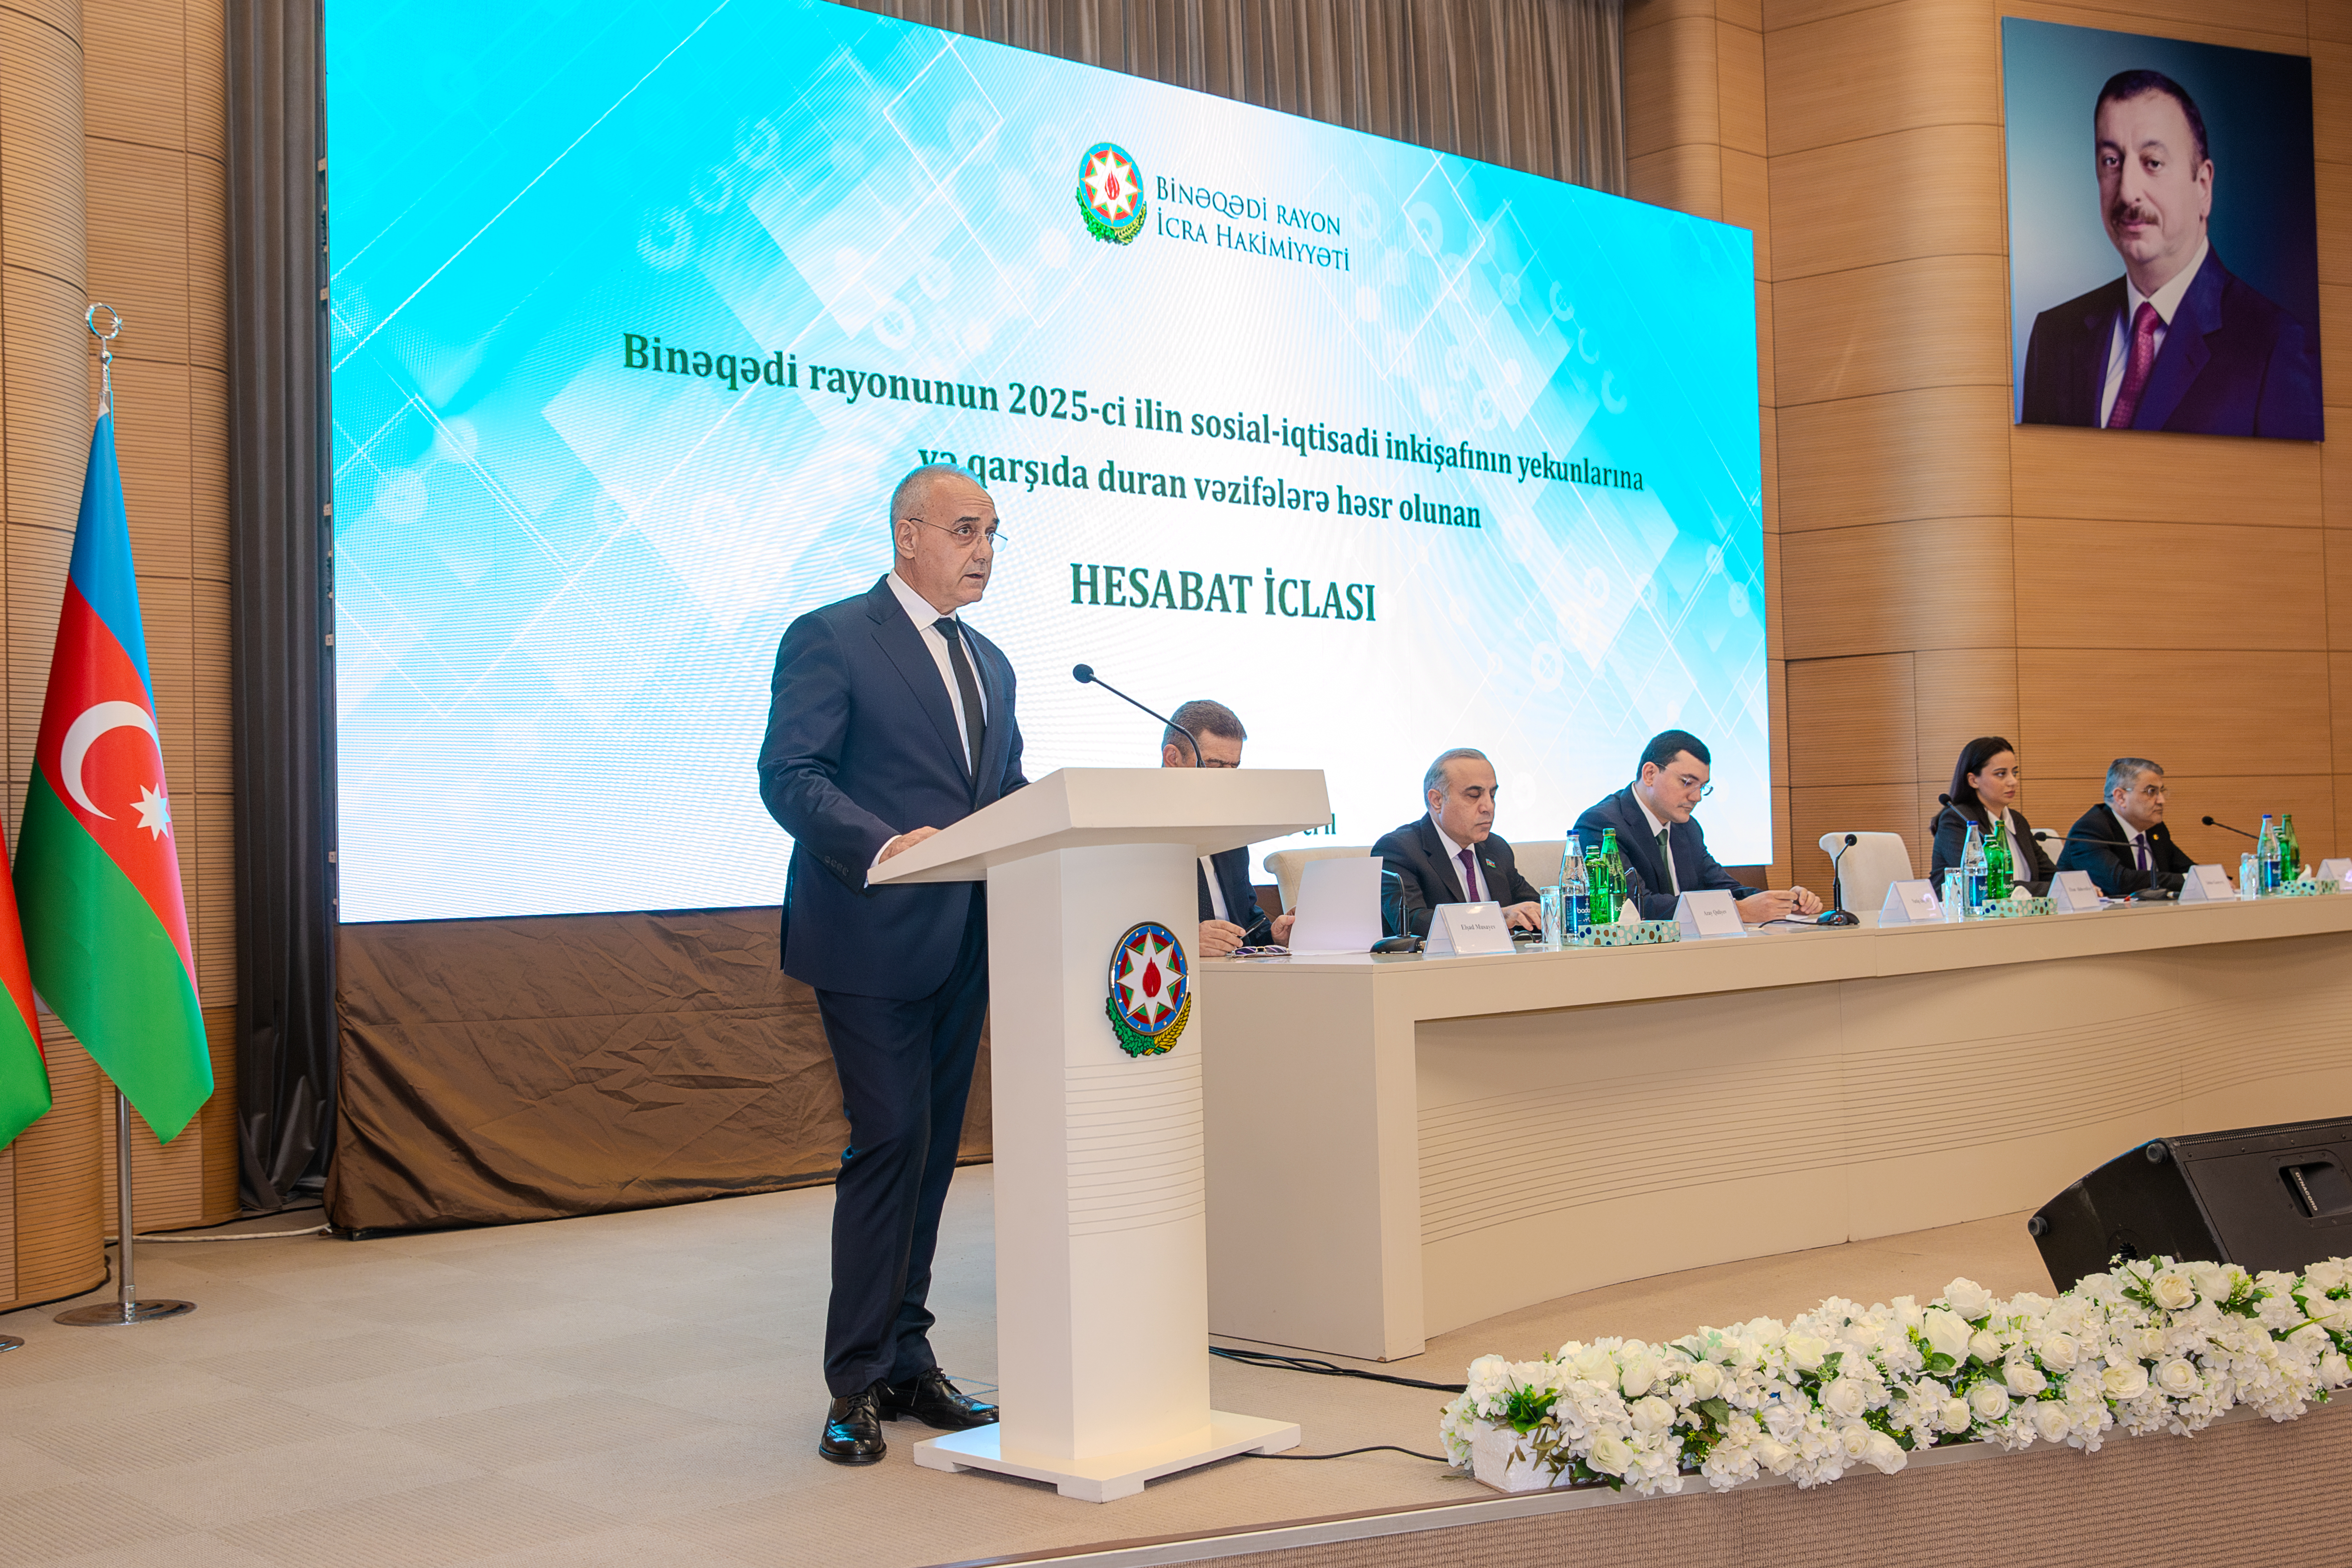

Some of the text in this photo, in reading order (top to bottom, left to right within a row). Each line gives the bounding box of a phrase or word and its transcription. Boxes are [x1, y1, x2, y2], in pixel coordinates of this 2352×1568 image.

[1158, 207, 1208, 244] İCRA
[1277, 205, 1340, 235] RAYON
[623, 333, 1644, 491] Binəqədi rayonunun 2025-ci ilin sosial-iqtisadi inkişafının yekunlarına
[968, 455, 1090, 493] qarşıda
[1099, 460, 1187, 499] duran
[1195, 476, 1329, 513] vəzifələrə
[1337, 485, 1393, 519] həsr
[1400, 494, 1481, 528] olunan
[1071, 563, 1376, 621] HESABAT İCLASI
[2295, 1172, 2318, 1211] DYNACORD
